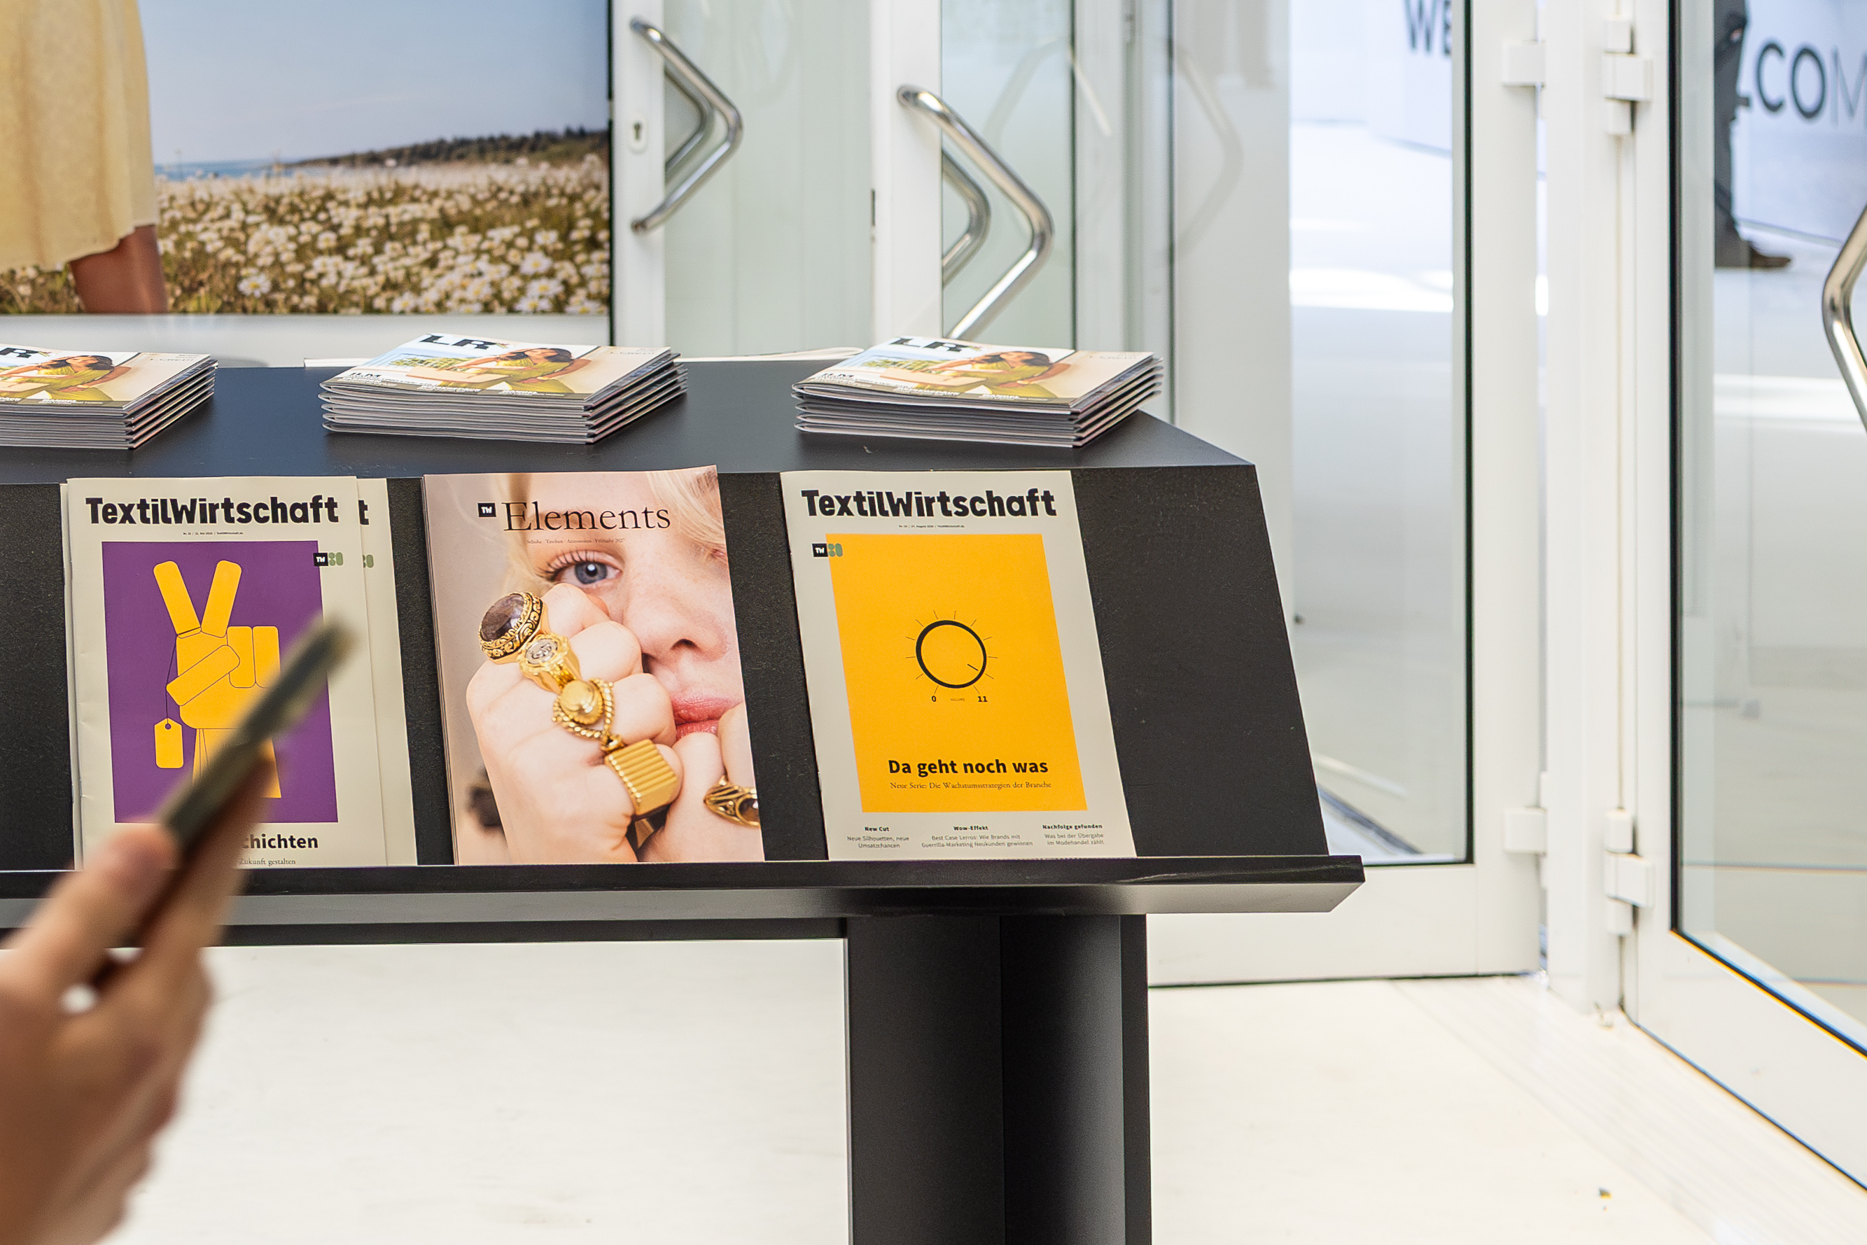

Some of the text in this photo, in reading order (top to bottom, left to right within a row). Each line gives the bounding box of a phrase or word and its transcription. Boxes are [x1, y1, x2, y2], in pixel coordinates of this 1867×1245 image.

[1735, 42, 1867, 126] COM
[419, 333, 498, 350] LR
[890, 337, 971, 354] LR
[85, 494, 339, 525] TextilWirtschaft
[801, 488, 1057, 517] TextilWirtschaft
[501, 500, 671, 532] Elements
[931, 695, 937, 703] 0
[977, 695, 988, 703] 11
[888, 758, 1049, 778] Da geht noch was
[1012, 781, 1023, 789] der
[1025, 781, 1052, 789] Branche
[268, 857, 296, 867] gestalten
